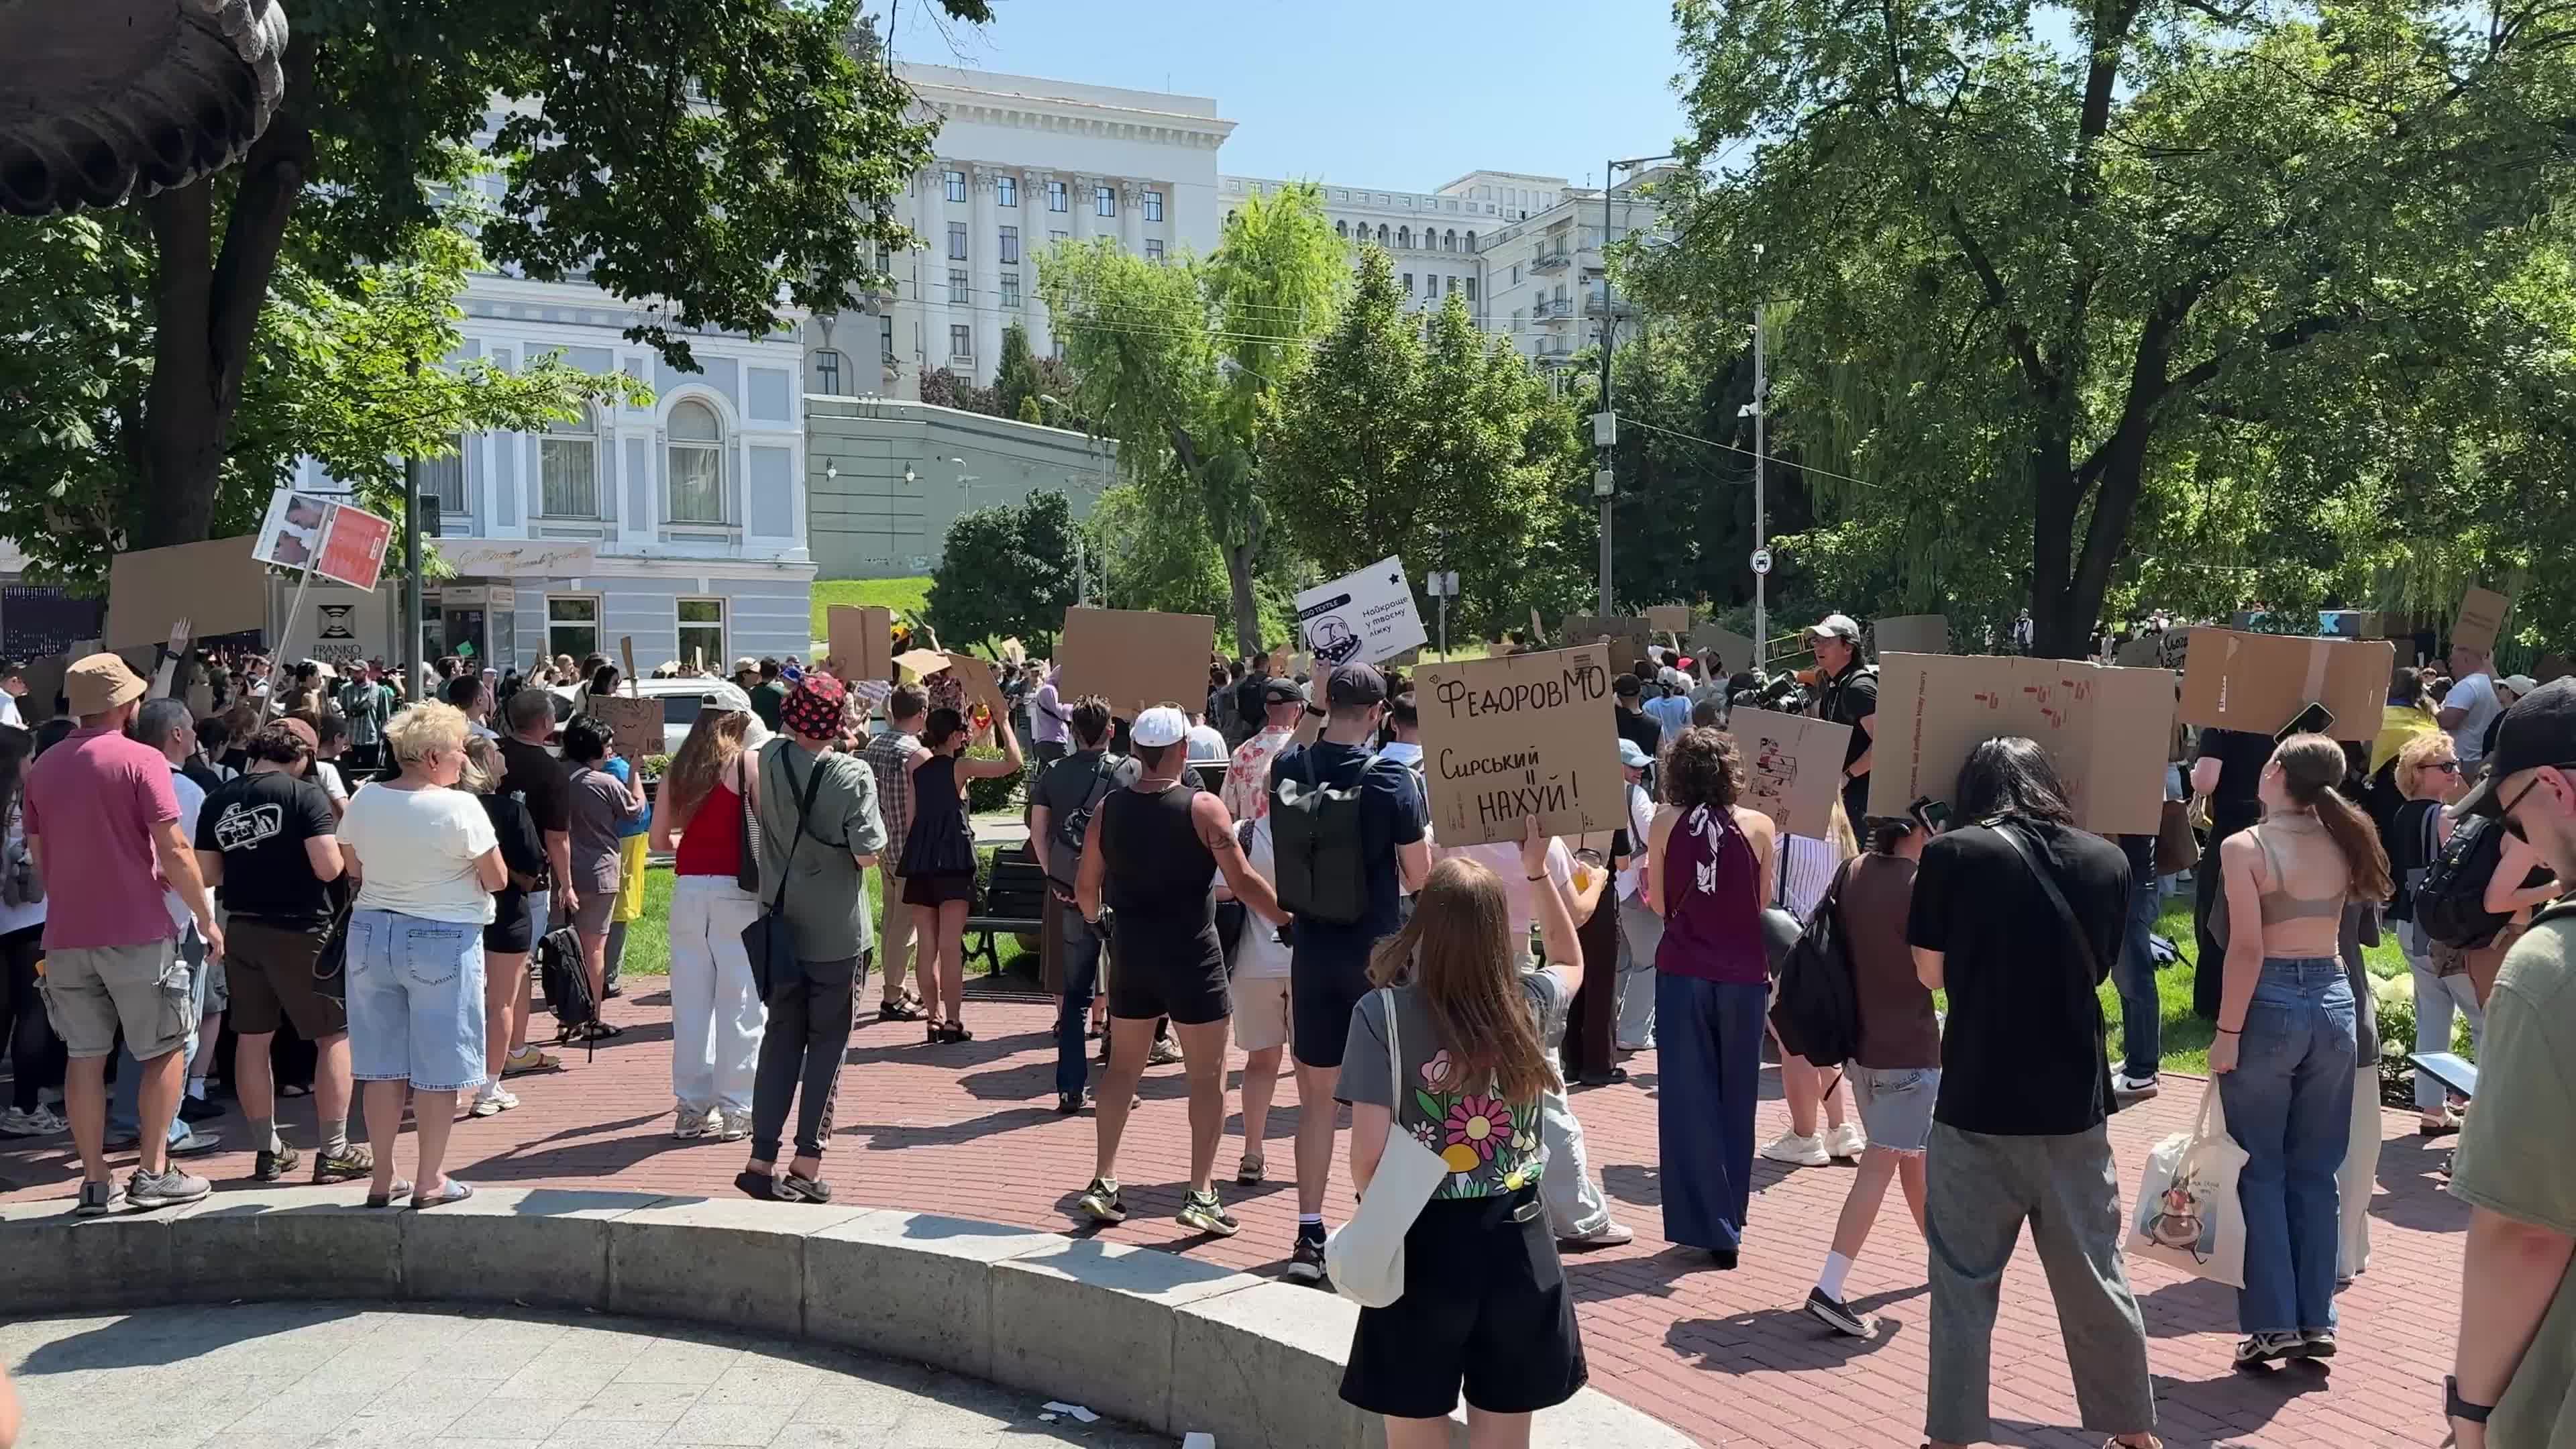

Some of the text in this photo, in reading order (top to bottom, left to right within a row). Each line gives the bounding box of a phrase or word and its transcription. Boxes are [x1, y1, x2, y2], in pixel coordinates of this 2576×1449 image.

[1301, 599, 1339, 619] EGO TEXTILE
[1362, 596, 1407, 618] Найкраще
[1365, 608, 1405, 629] у твоєму
[1369, 625, 1392, 638] ліжку
[313, 644, 362, 654] FRANKO
[1440, 745, 1540, 780] Сирський
